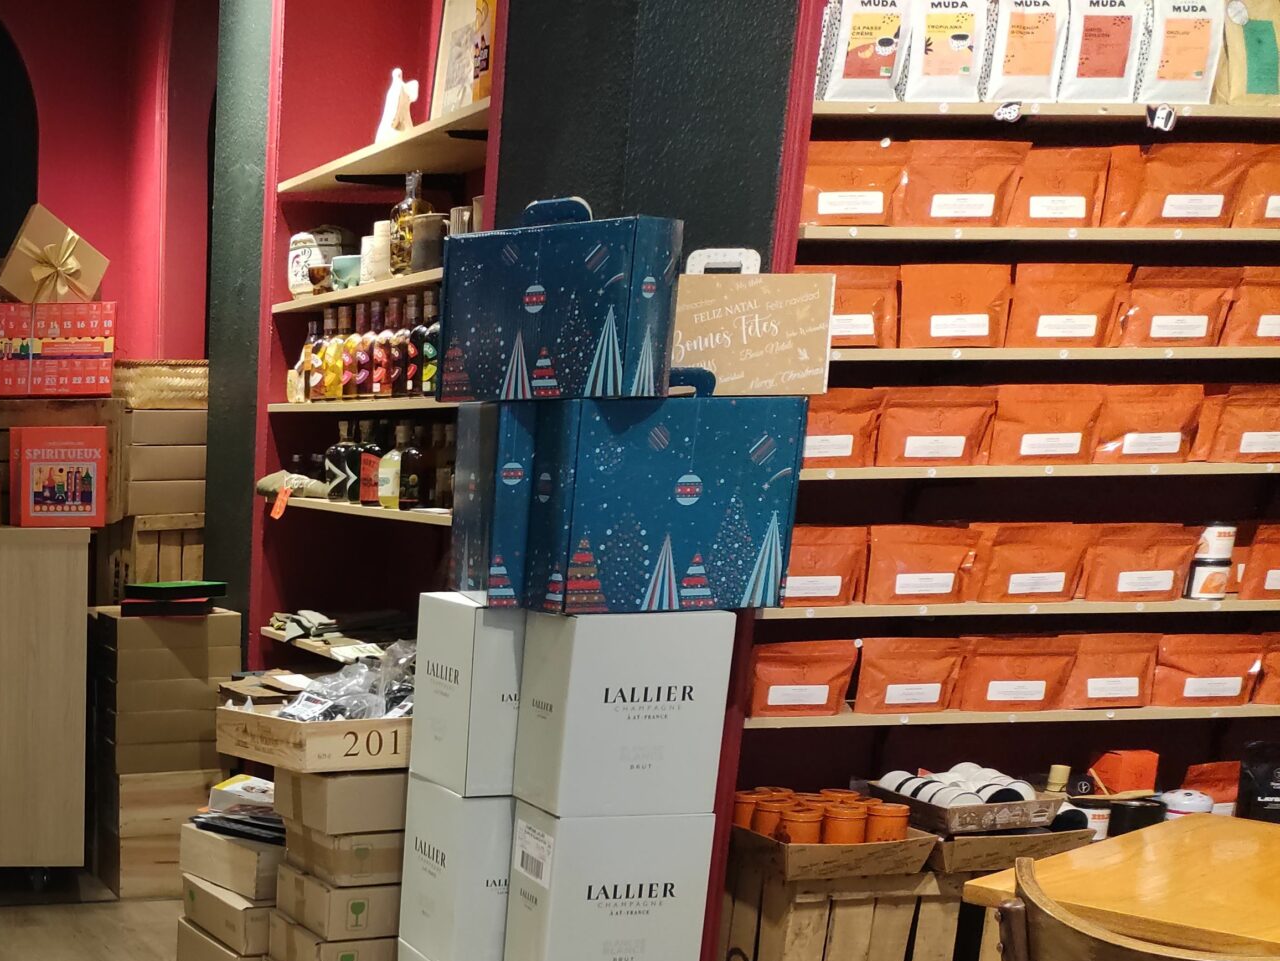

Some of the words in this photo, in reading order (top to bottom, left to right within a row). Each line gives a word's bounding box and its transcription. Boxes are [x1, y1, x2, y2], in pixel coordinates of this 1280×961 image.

[931, 1, 968, 9] MUDA
[1089, 0, 1126, 8] MUDA
[1172, 5, 1207, 13] MUDA
[694, 307, 723, 324] FELIZ
[725, 299, 760, 316] NATAL
[25, 448, 102, 460] SPIRITUEUX
[427, 660, 460, 685] LALLIER
[604, 685, 695, 703] LALLIER
[531, 698, 553, 713] LALLIER
[343, 729, 401, 758] 201
[414, 836, 447, 869] LALLIER
[587, 883, 676, 901] LALLIER
